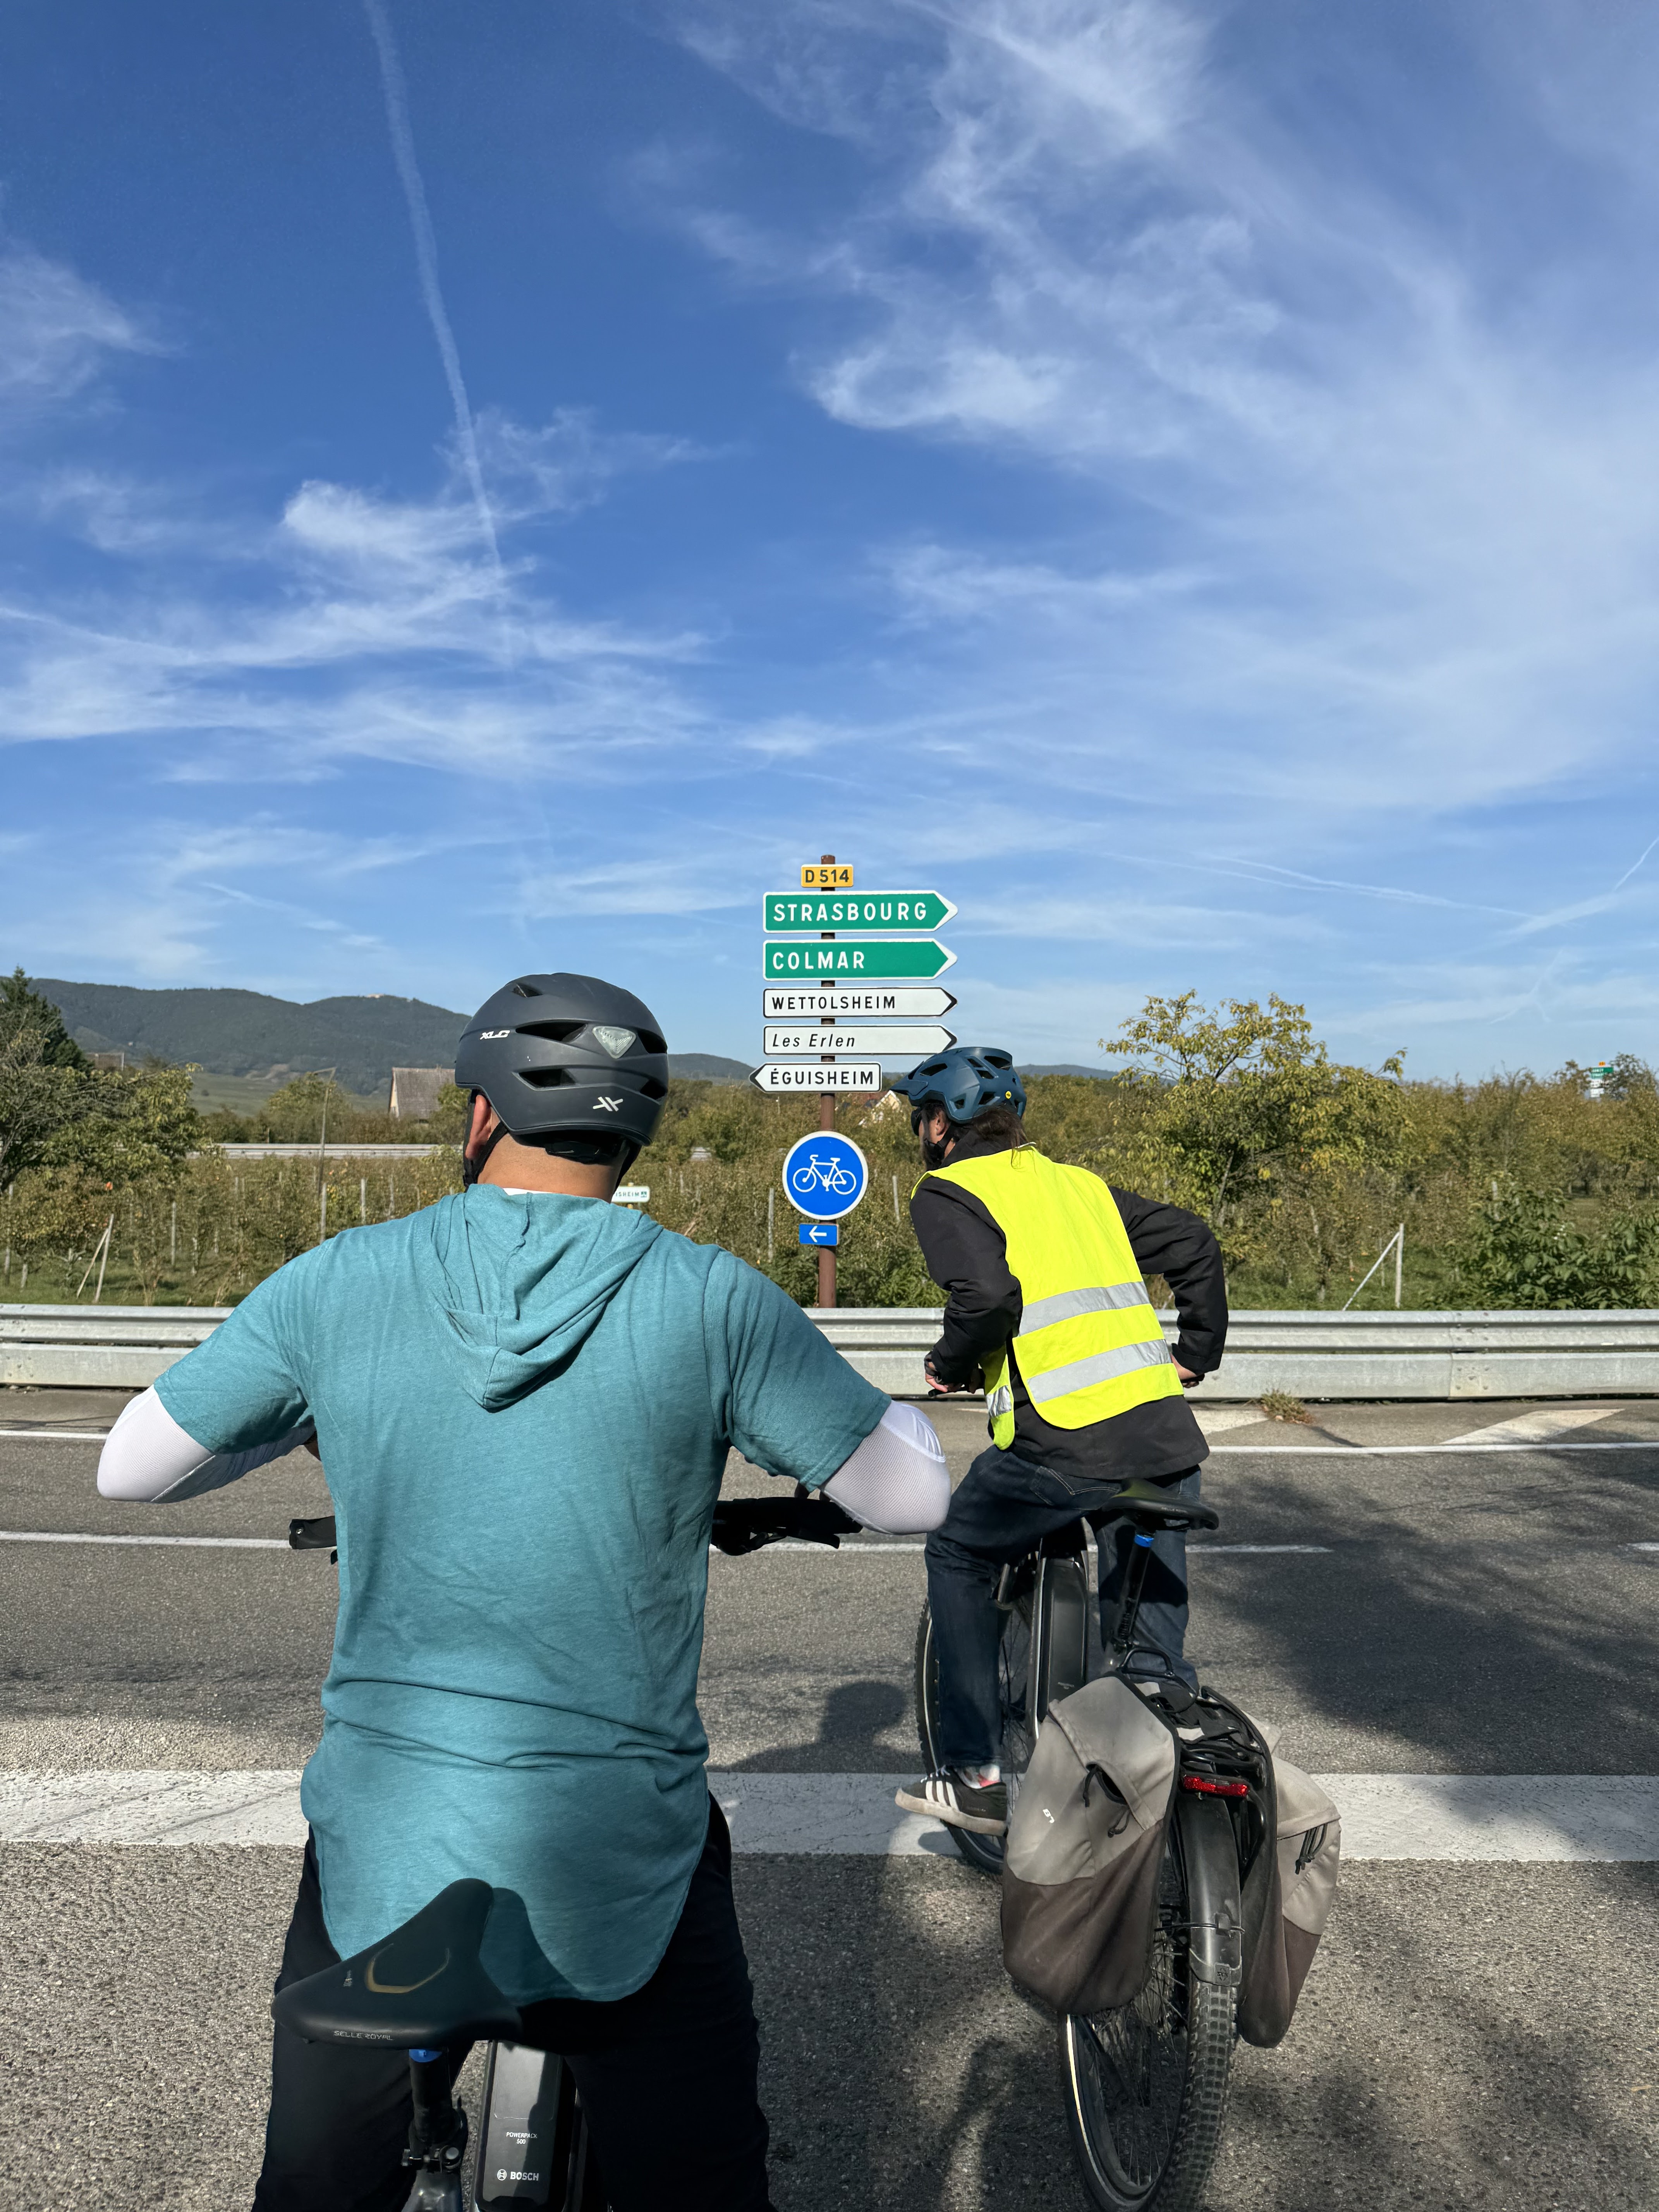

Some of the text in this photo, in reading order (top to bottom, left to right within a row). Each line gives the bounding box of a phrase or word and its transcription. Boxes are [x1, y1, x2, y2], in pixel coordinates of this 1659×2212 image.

[805, 869, 849, 883] D 514
[774, 902, 926, 921] STRASBOURG
[773, 951, 864, 969] COLMAR
[772, 996, 895, 1009] WETTOLSHEIM
[773, 1034, 855, 1047] Les Erlen
[771, 1068, 873, 1085] ÉGUISHEIM
[510, 2171, 539, 2181] BOSCH
